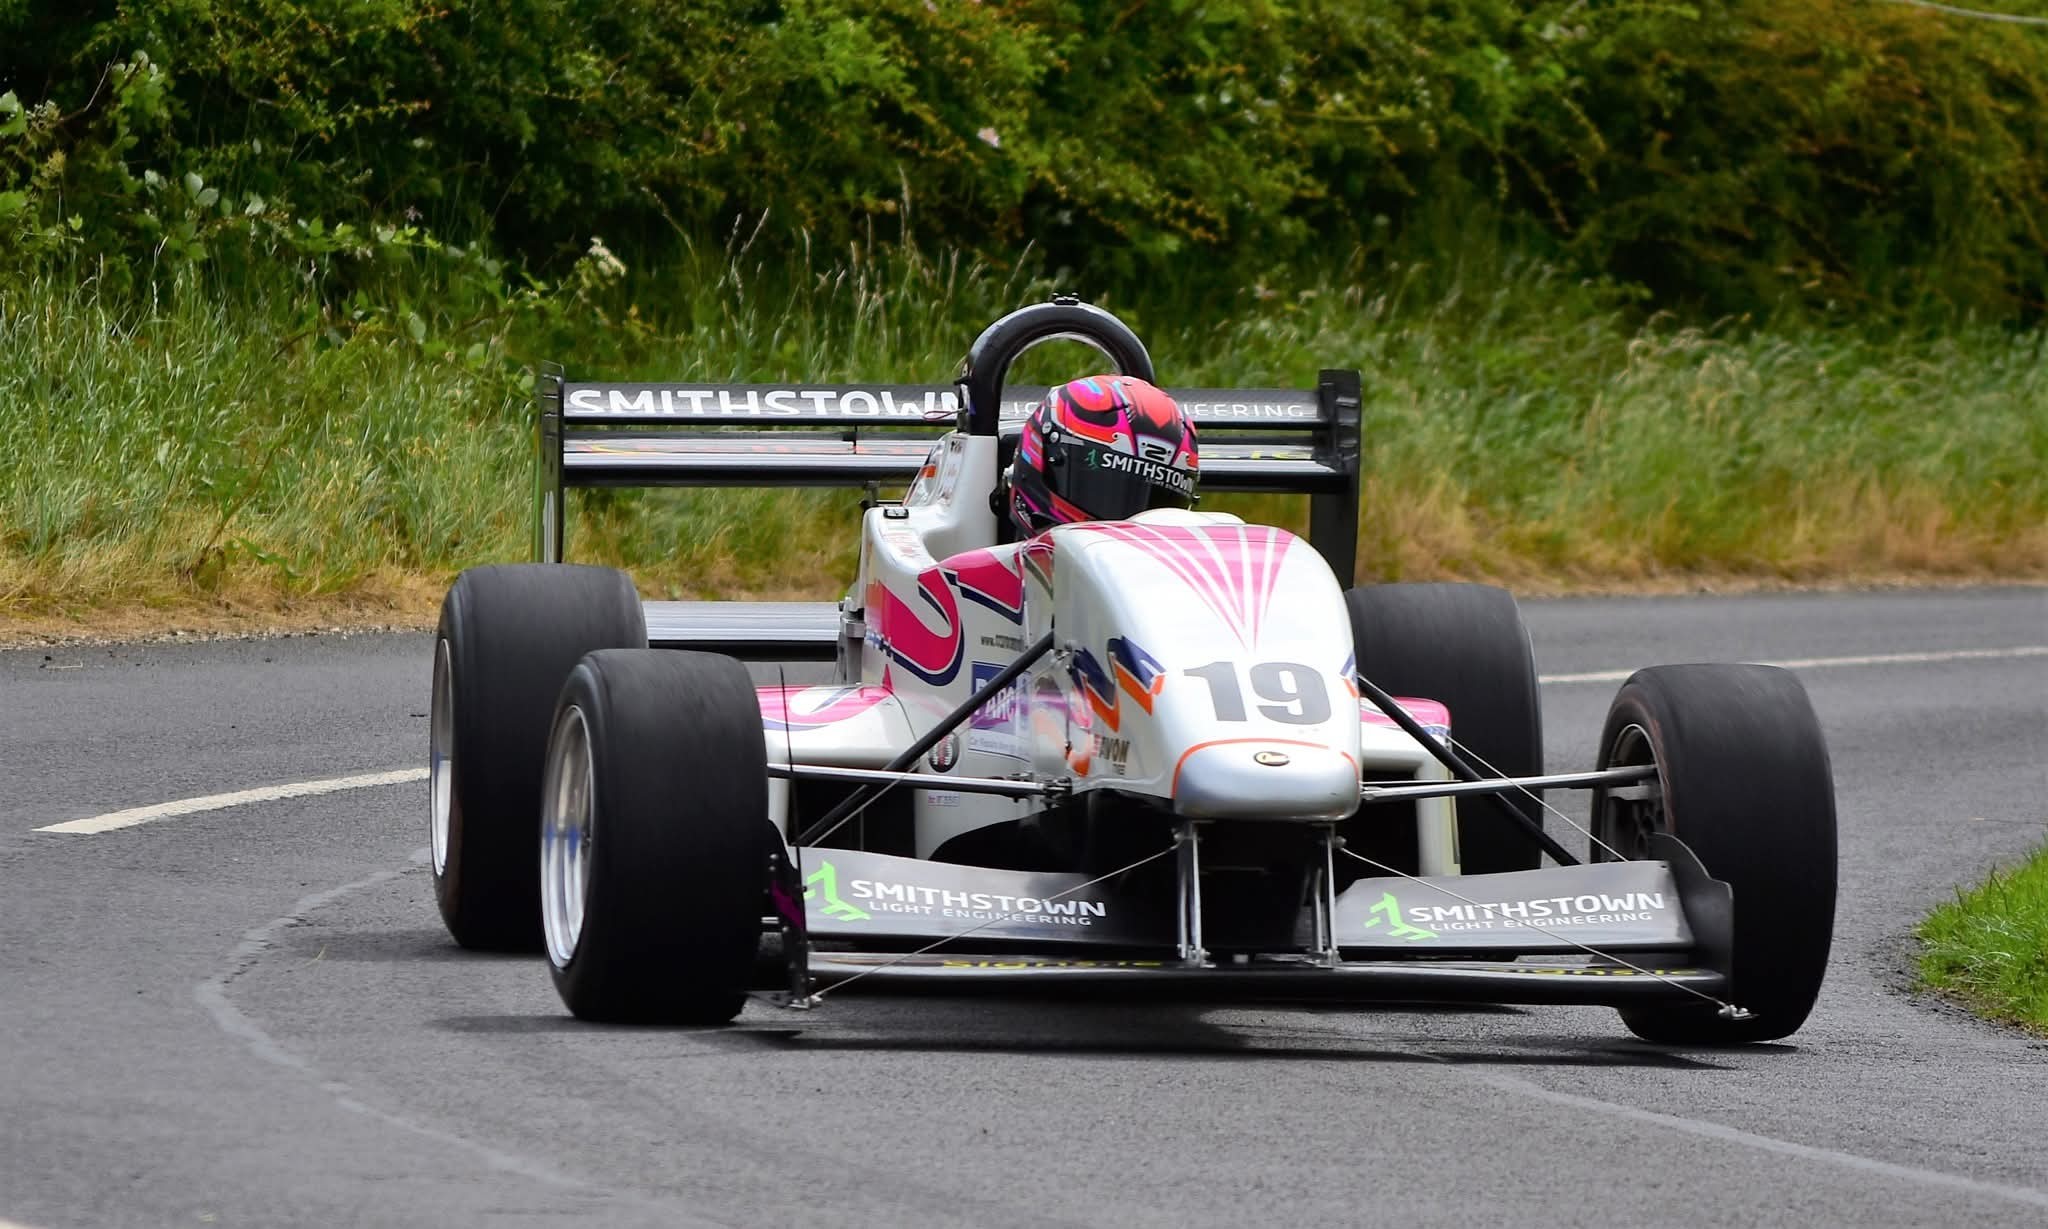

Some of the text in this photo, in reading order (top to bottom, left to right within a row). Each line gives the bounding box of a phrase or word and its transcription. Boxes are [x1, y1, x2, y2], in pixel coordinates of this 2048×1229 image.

[1184, 661, 1332, 725] 19
[851, 879, 1106, 917] SMITHSTOWN
[1411, 893, 1665, 923] SMITHSTOWN
[868, 901, 1092, 926] LIGHT ENGINEERING
[1429, 911, 1653, 932] LIGHT ENGINEERING
